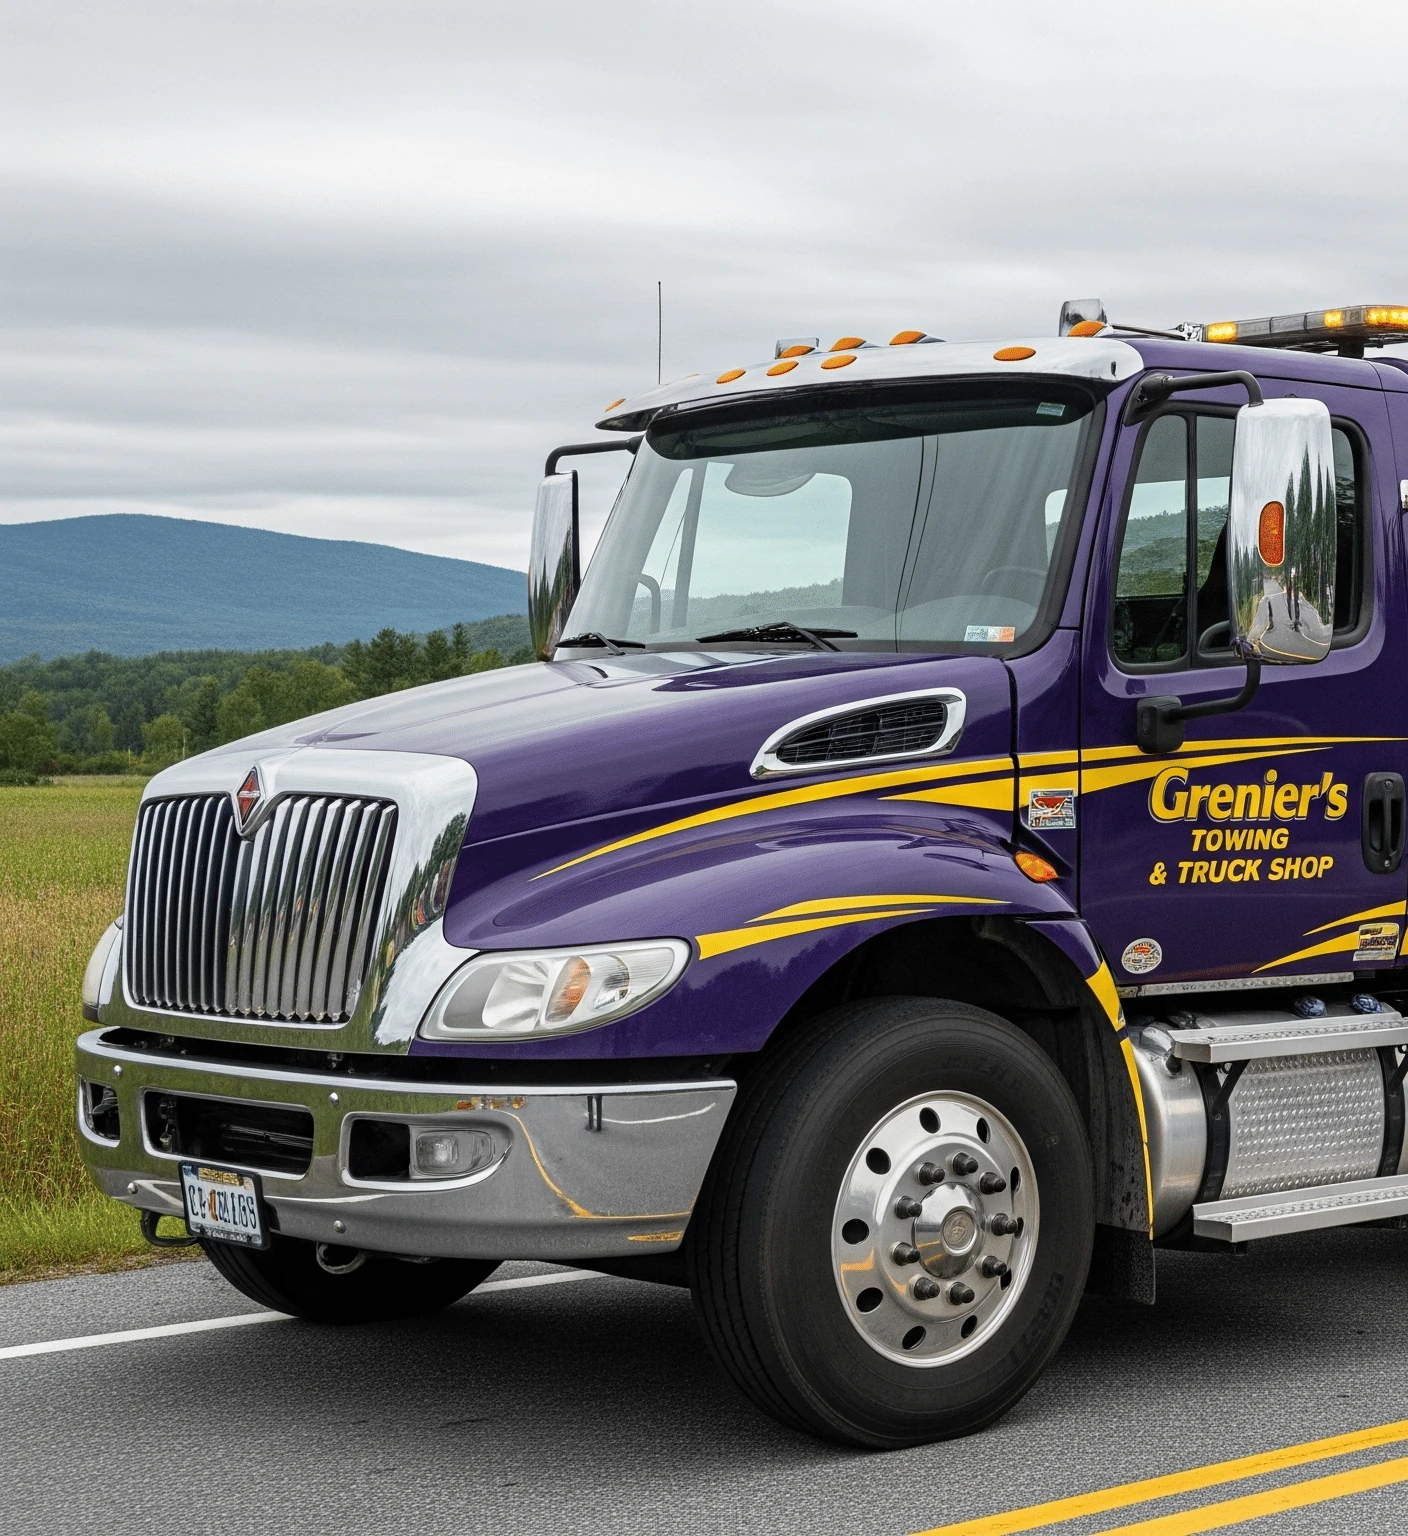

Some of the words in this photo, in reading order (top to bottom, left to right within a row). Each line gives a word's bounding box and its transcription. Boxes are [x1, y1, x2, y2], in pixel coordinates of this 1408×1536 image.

[1148, 766, 1348, 823] Grenier's
[1191, 828, 1289, 852] TOWING
[1149, 862, 1168, 885] &
[1178, 858, 1260, 883] TRUCK
[1268, 855, 1334, 880] SHOP
